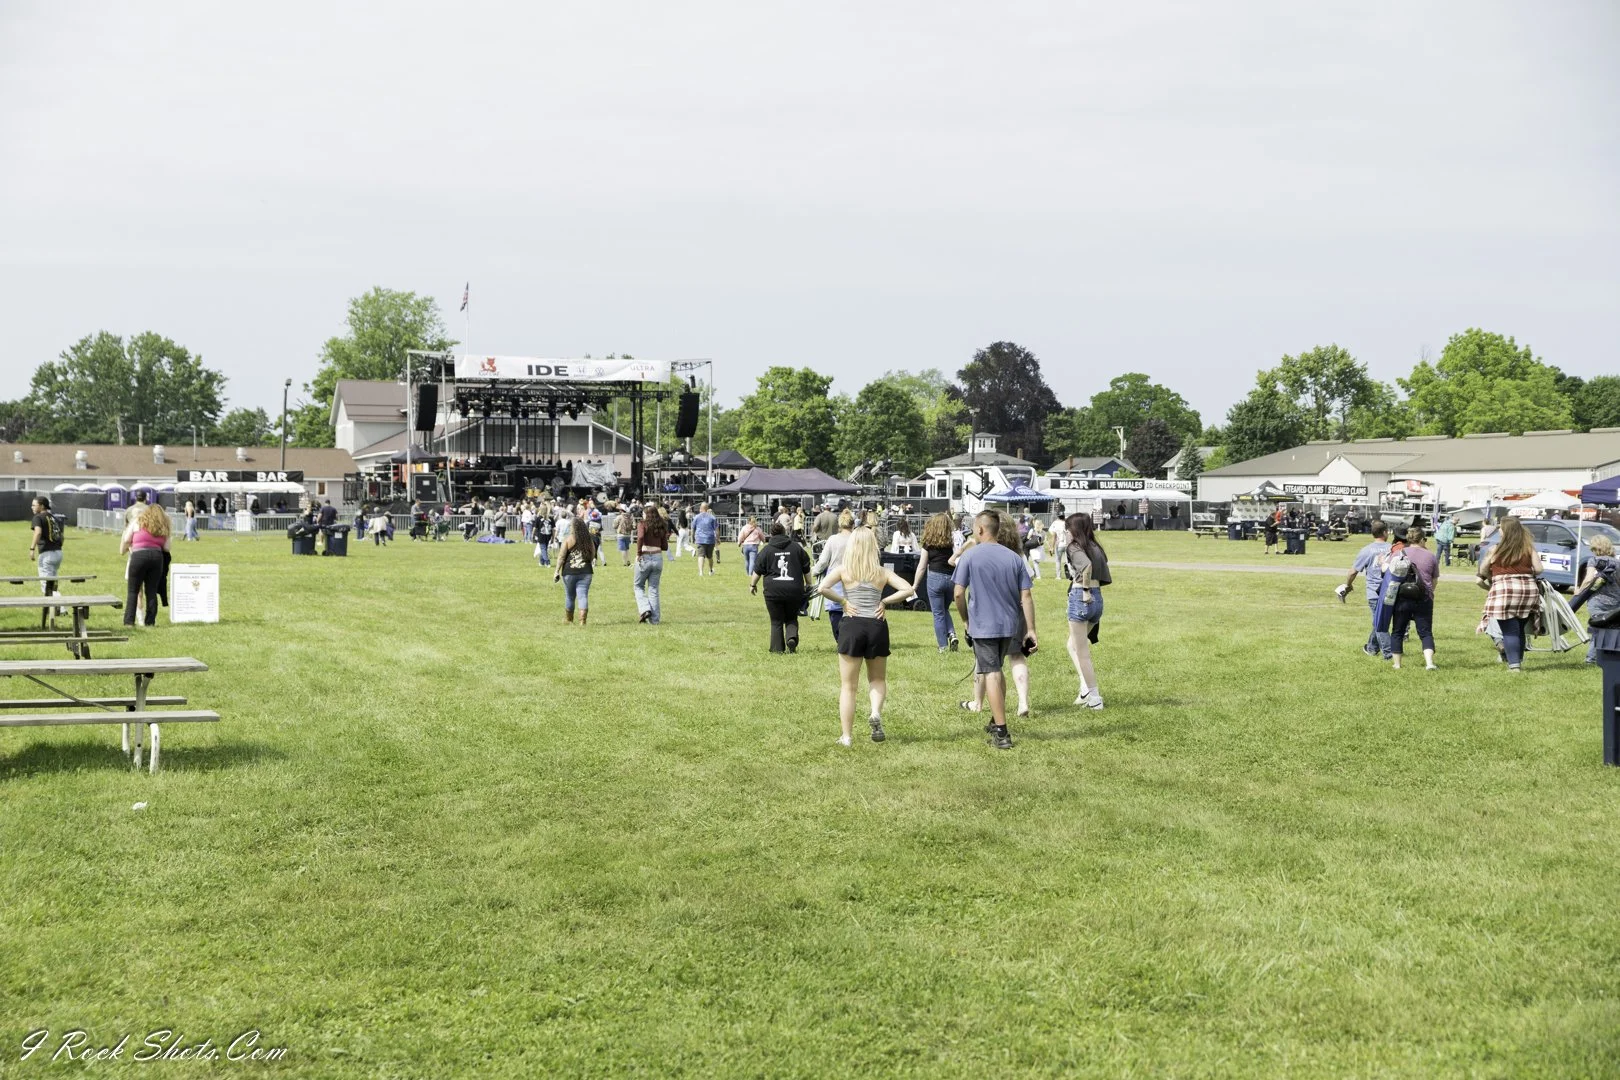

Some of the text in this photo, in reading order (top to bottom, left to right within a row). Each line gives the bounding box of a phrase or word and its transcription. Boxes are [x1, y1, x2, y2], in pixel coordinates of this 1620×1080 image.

[527, 364, 570, 377] IDE
[189, 471, 229, 482] BAR
[256, 471, 288, 482] BAR
[1060, 480, 1089, 489] BAR
[1100, 481, 1143, 489] BLUE WHALES
[1154, 482, 1190, 490] CHECKPOINT
[1285, 485, 1324, 494] STEAMED CLAMS
[1327, 486, 1367, 495] STEAMED CLAMS
